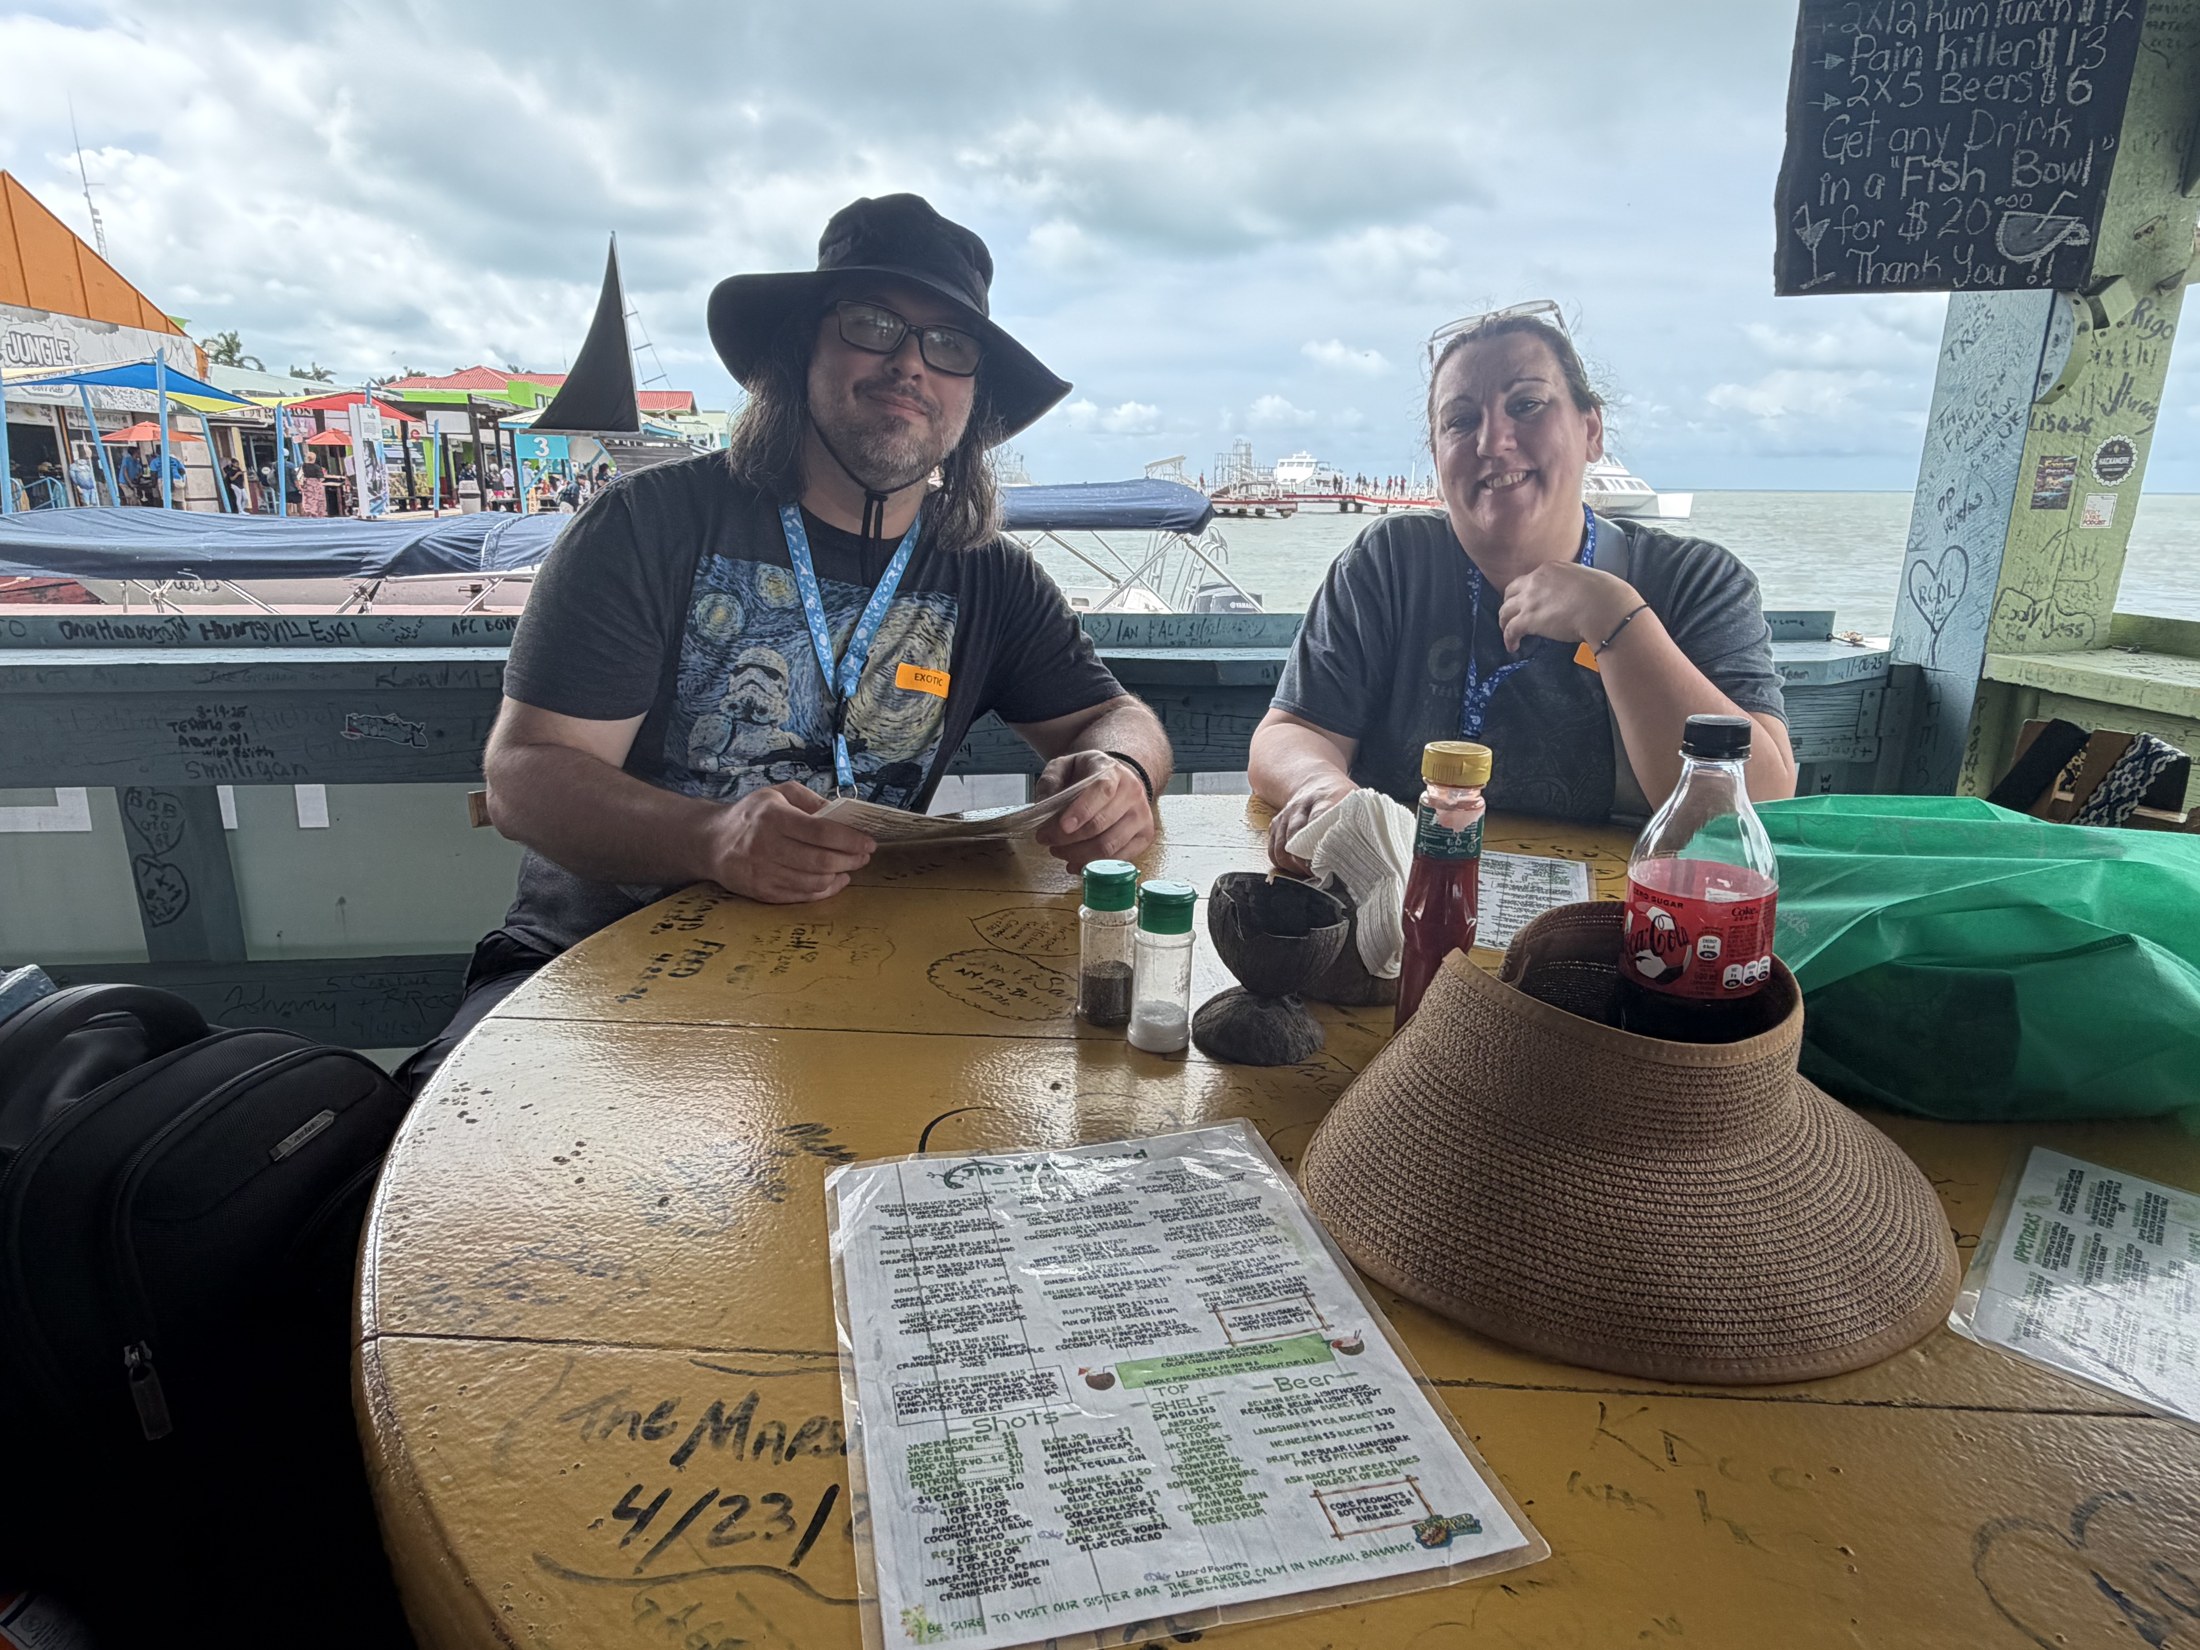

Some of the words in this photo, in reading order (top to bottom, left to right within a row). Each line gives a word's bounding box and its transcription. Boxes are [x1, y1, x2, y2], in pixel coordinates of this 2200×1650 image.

[1849, 34, 1923, 75] Pain
[1939, 70, 2033, 104] Beers
[1822, 109, 1881, 165] Get
[1887, 122, 1951, 168] any
[1963, 108, 2073, 152] Drink
[1819, 171, 1851, 207] in
[1863, 173, 1886, 200] a
[1833, 203, 1885, 245] for
[1845, 244, 1941, 286] Thank
[6, 330, 73, 367] JUNGLE
[533, 436, 551, 458] 3
[914, 673, 944, 687] EXOTIC
[1651, 895, 1684, 910] SUGAR
[1731, 906, 1757, 917] Coke
[1152, 1383, 1191, 1397] TOP
[1272, 1369, 1338, 1392] Beer
[1150, 1395, 1211, 1413] SHELF
[1152, 1412, 1168, 1421] SM
[1168, 1410, 1186, 1418] $10
[1199, 1405, 1216, 1414] $15
[971, 1407, 1061, 1435] Shots
[1159, 1426, 1189, 1436] GREY
[1188, 1421, 1223, 1432] GOOSE
[1252, 1420, 1310, 1436] LANDSHARK
[1337, 1410, 1377, 1422] BUCKET
[1374, 1406, 1397, 1416] $20
[1269, 1433, 1323, 1448] HEINEKEN
[1335, 1425, 1375, 1437] BUCKET
[1373, 1421, 1396, 1431] $25
[1127, 1453, 1146, 1462] GIN
[1176, 1443, 1226, 1456] JAMESON
[1375, 1444, 1398, 1453] $20
[1169, 1460, 1209, 1473] CROWN
[1209, 1455, 1244, 1466] ROYAL
[1177, 1463, 1242, 1479] TANQUERAY
[986, 1475, 1017, 1486] SHOT
[1166, 1476, 1207, 1489] BOMBAY
[1206, 1468, 1260, 1483] SAPPHIRE
[950, 1489, 968, 1499] OR
[980, 1484, 1003, 1495] FOR
[1005, 1481, 1025, 1491] $10
[1197, 1487, 1242, 1501] PATRON
[1176, 1498, 1222, 1512] CAPTAIN
[1222, 1491, 1269, 1505] MORGAN
[1328, 1500, 1356, 1510] COKE
[1355, 1491, 1407, 1506] PRODUCTS
[1336, 1503, 1380, 1517] BOTTLED
[1378, 1497, 1415, 1510] WATER
[931, 1518, 990, 1534] PINEAPPLE
[1068, 1506, 1158, 1528] JAGERMEISTER
[931, 1548, 955, 1559] RED
[957, 1540, 1002, 1555] HEADED
[1004, 1535, 1033, 1546] SLUT
[1064, 1534, 1094, 1546] LIME
[1014, 1558, 1049, 1571] PEACH
[939, 1582, 1007, 1602] CRANBERRY
[1009, 1576, 1041, 1589] JUICE
[948, 1574, 1007, 1591] SCHNAPPS
[1007, 1570, 1029, 1581] AND
[950, 1615, 984, 1631] SURE
[991, 1611, 1011, 1624] TO
[1013, 1604, 1049, 1620] VISIT
[1052, 1599, 1080, 1613] OUR
[1083, 1590, 1131, 1607] SISTER
[1133, 1585, 1160, 1598] BAR
[1195, 1569, 1253, 1588] BEARDED
[1253, 1563, 1289, 1578] CALM
[1289, 1560, 1305, 1572] IN
